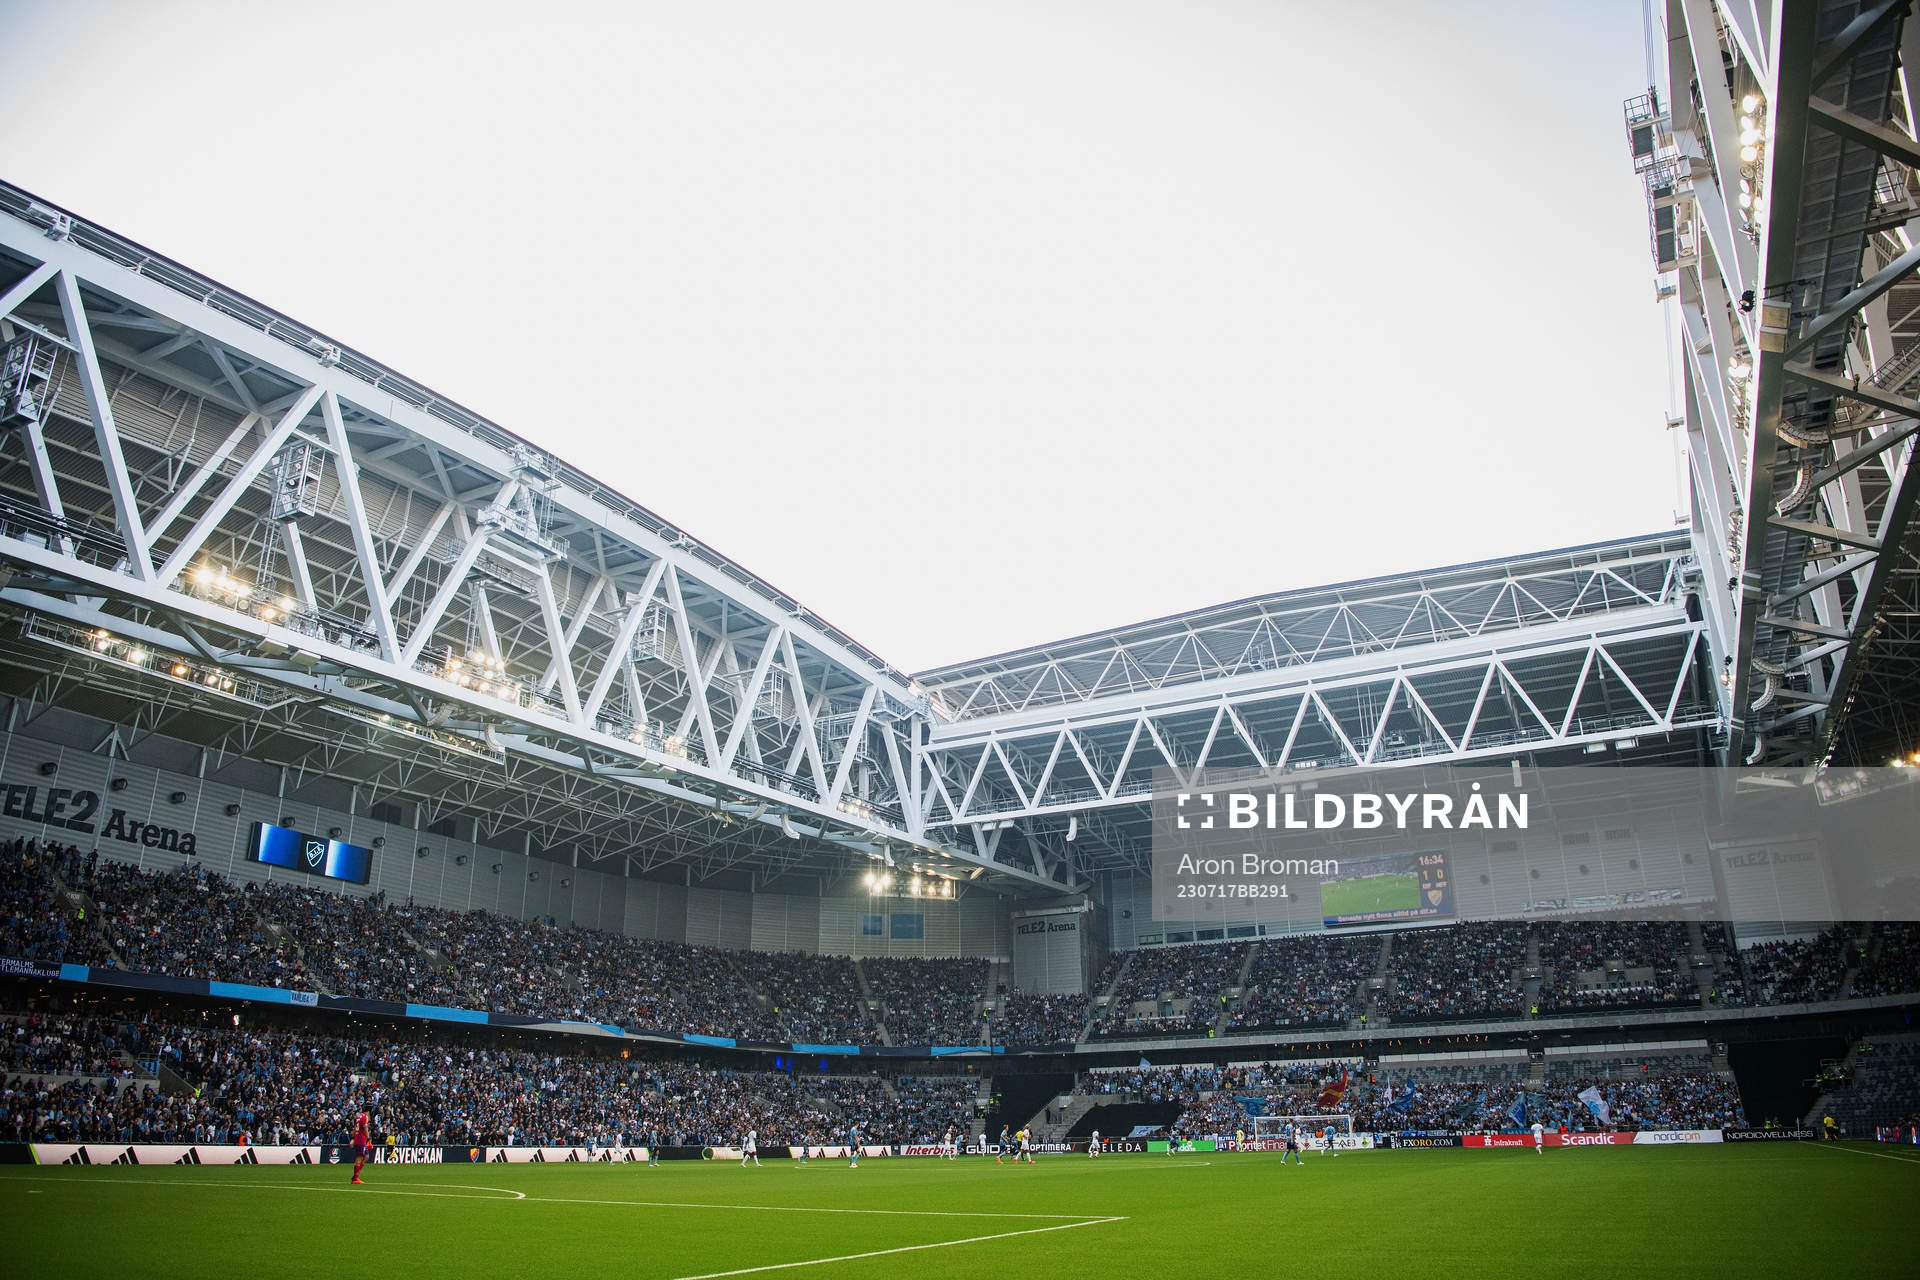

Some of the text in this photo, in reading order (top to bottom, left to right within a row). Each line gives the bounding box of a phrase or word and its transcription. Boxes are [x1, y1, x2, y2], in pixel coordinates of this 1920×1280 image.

[101, 808, 197, 856] Arena
[1418, 854, 1444, 866] 16:34
[1727, 850, 1816, 868] TELE2 Arena
[1422, 868, 1444, 881] 1 0
[1363, 913, 1376, 921] nytt
[1376, 911, 1392, 920] finns
[1393, 908, 1409, 918] alltid
[1419, 906, 1438, 915] dif.se
[1017, 921, 1076, 935] TELE2 Arena
[1228, 1139, 1267, 1151] Poritet
[1403, 1139, 1454, 1148] FXORO.COM
[1561, 1133, 1615, 1146] Scandic
